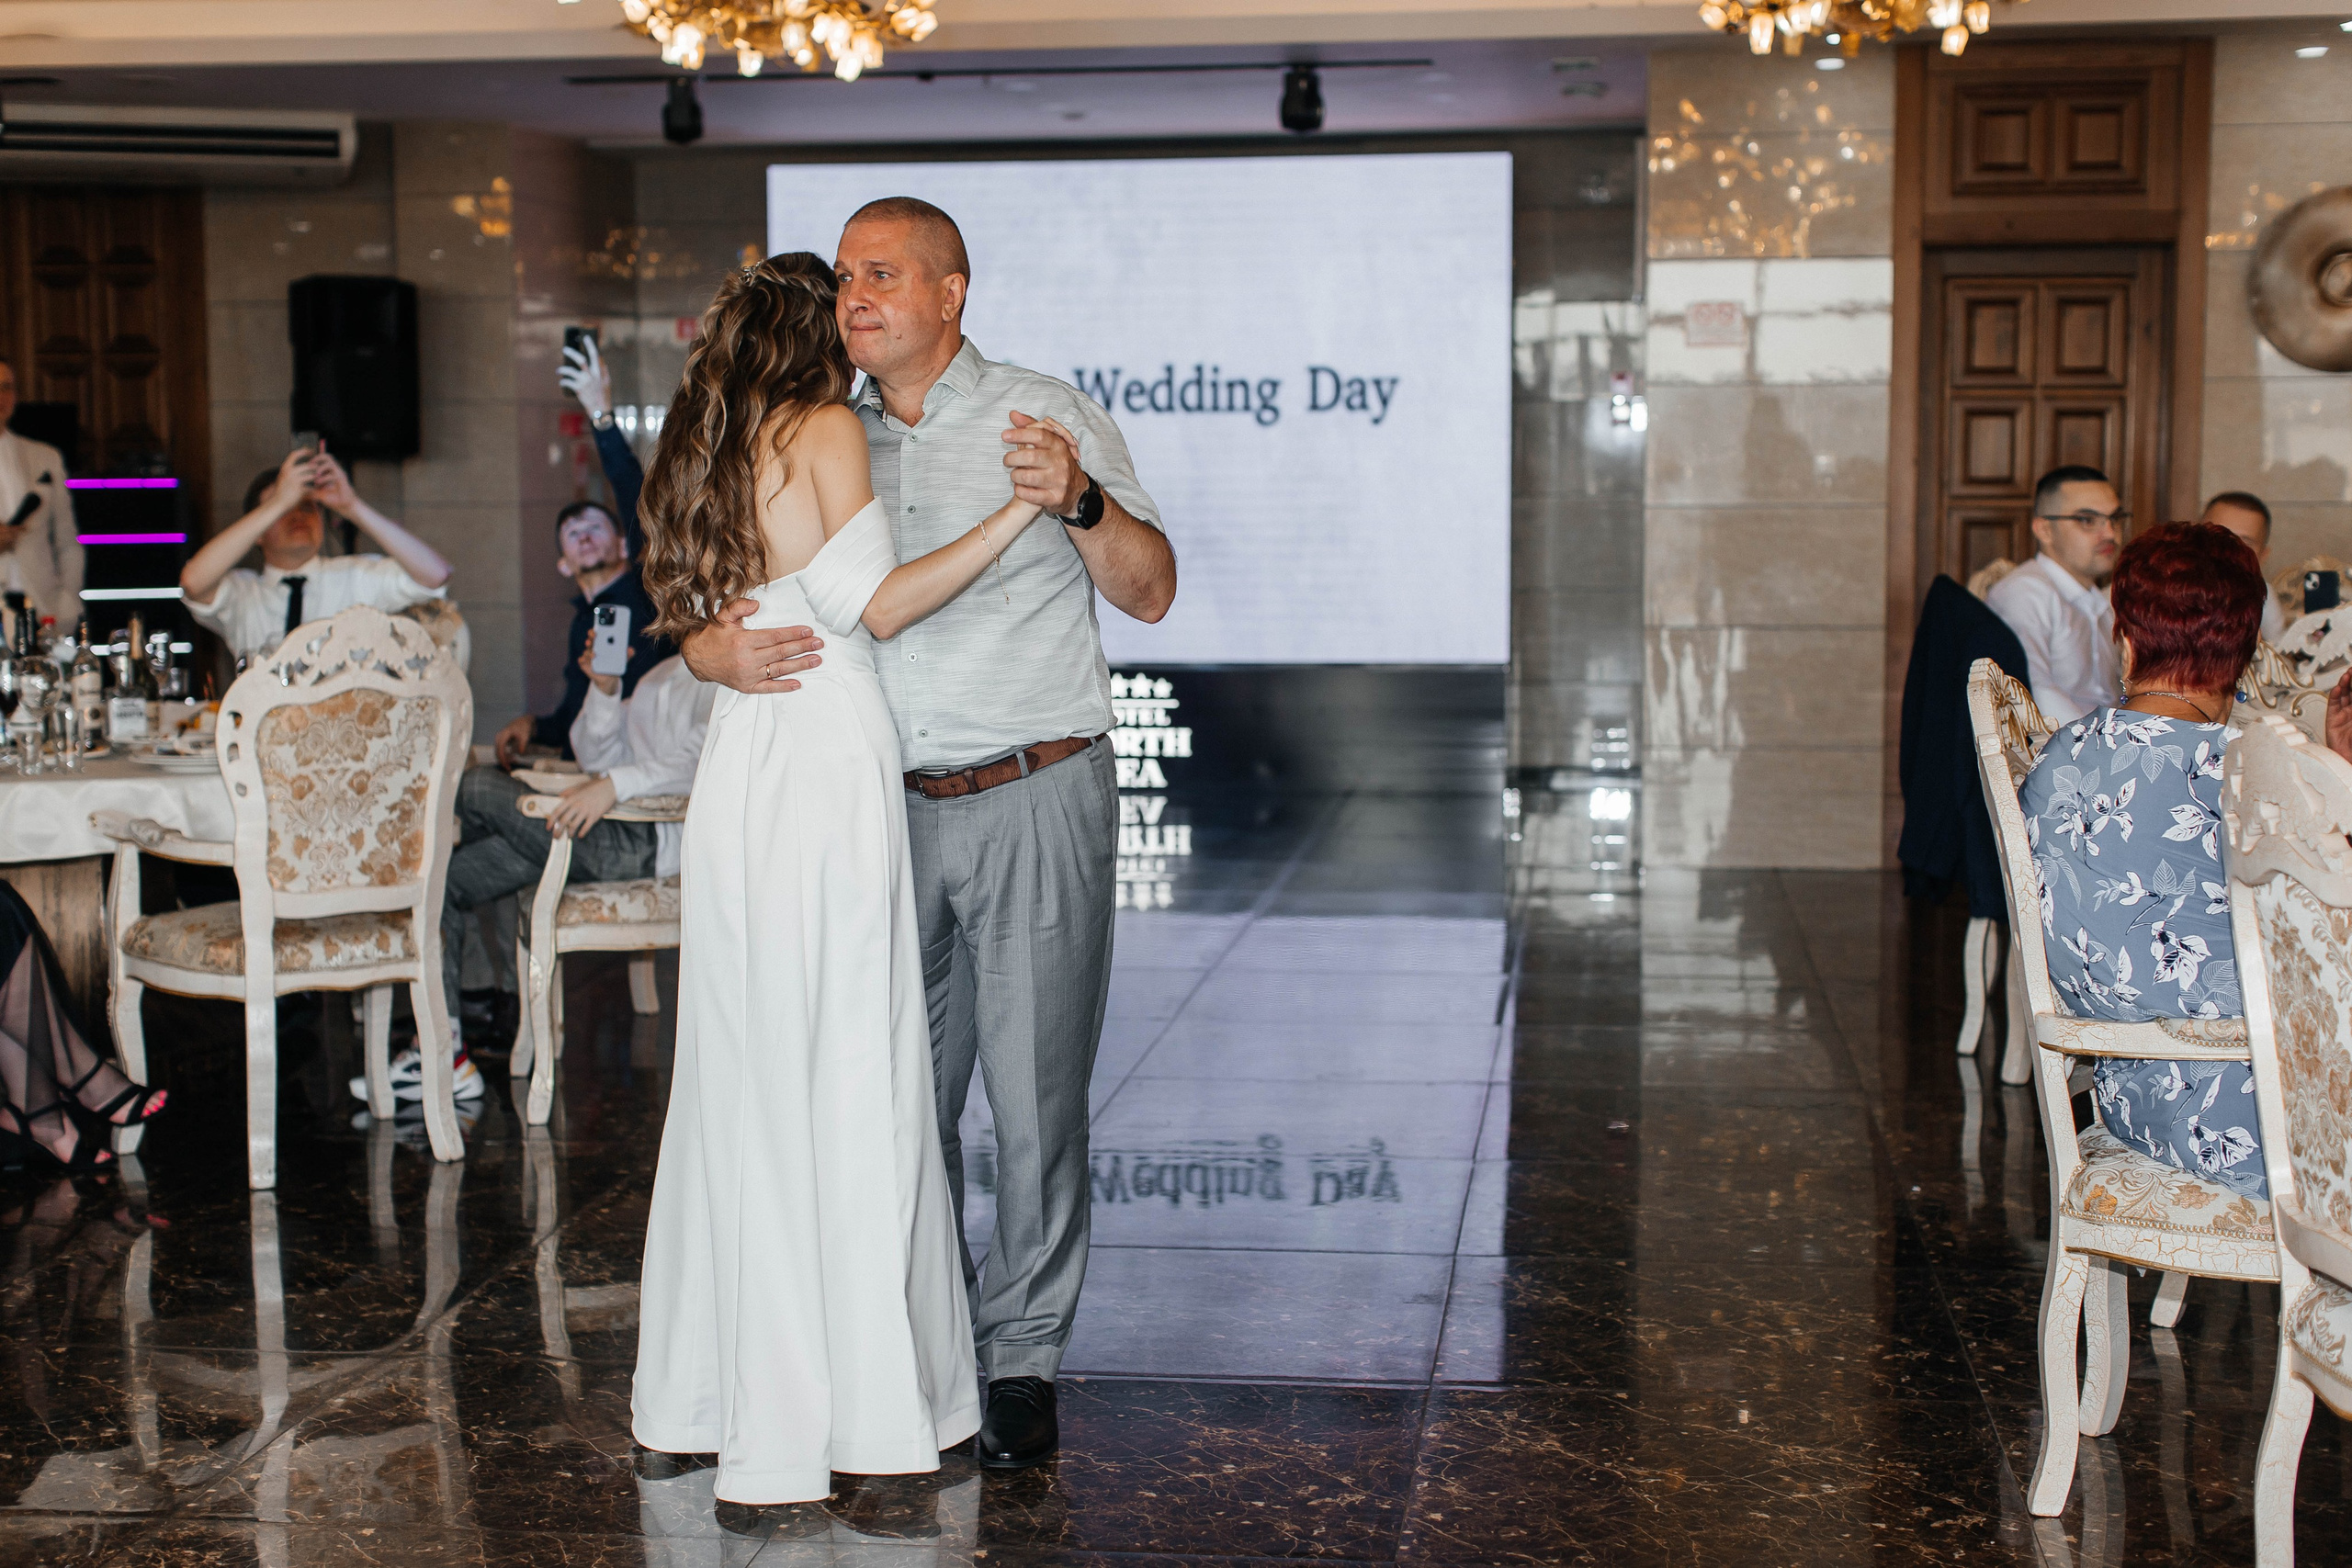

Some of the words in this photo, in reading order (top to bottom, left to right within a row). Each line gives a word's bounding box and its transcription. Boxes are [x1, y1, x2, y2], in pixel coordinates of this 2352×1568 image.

[1072, 363, 1282, 427] Wedding
[1306, 365, 1399, 426] Day
[1107, 727, 1193, 757] RTH
